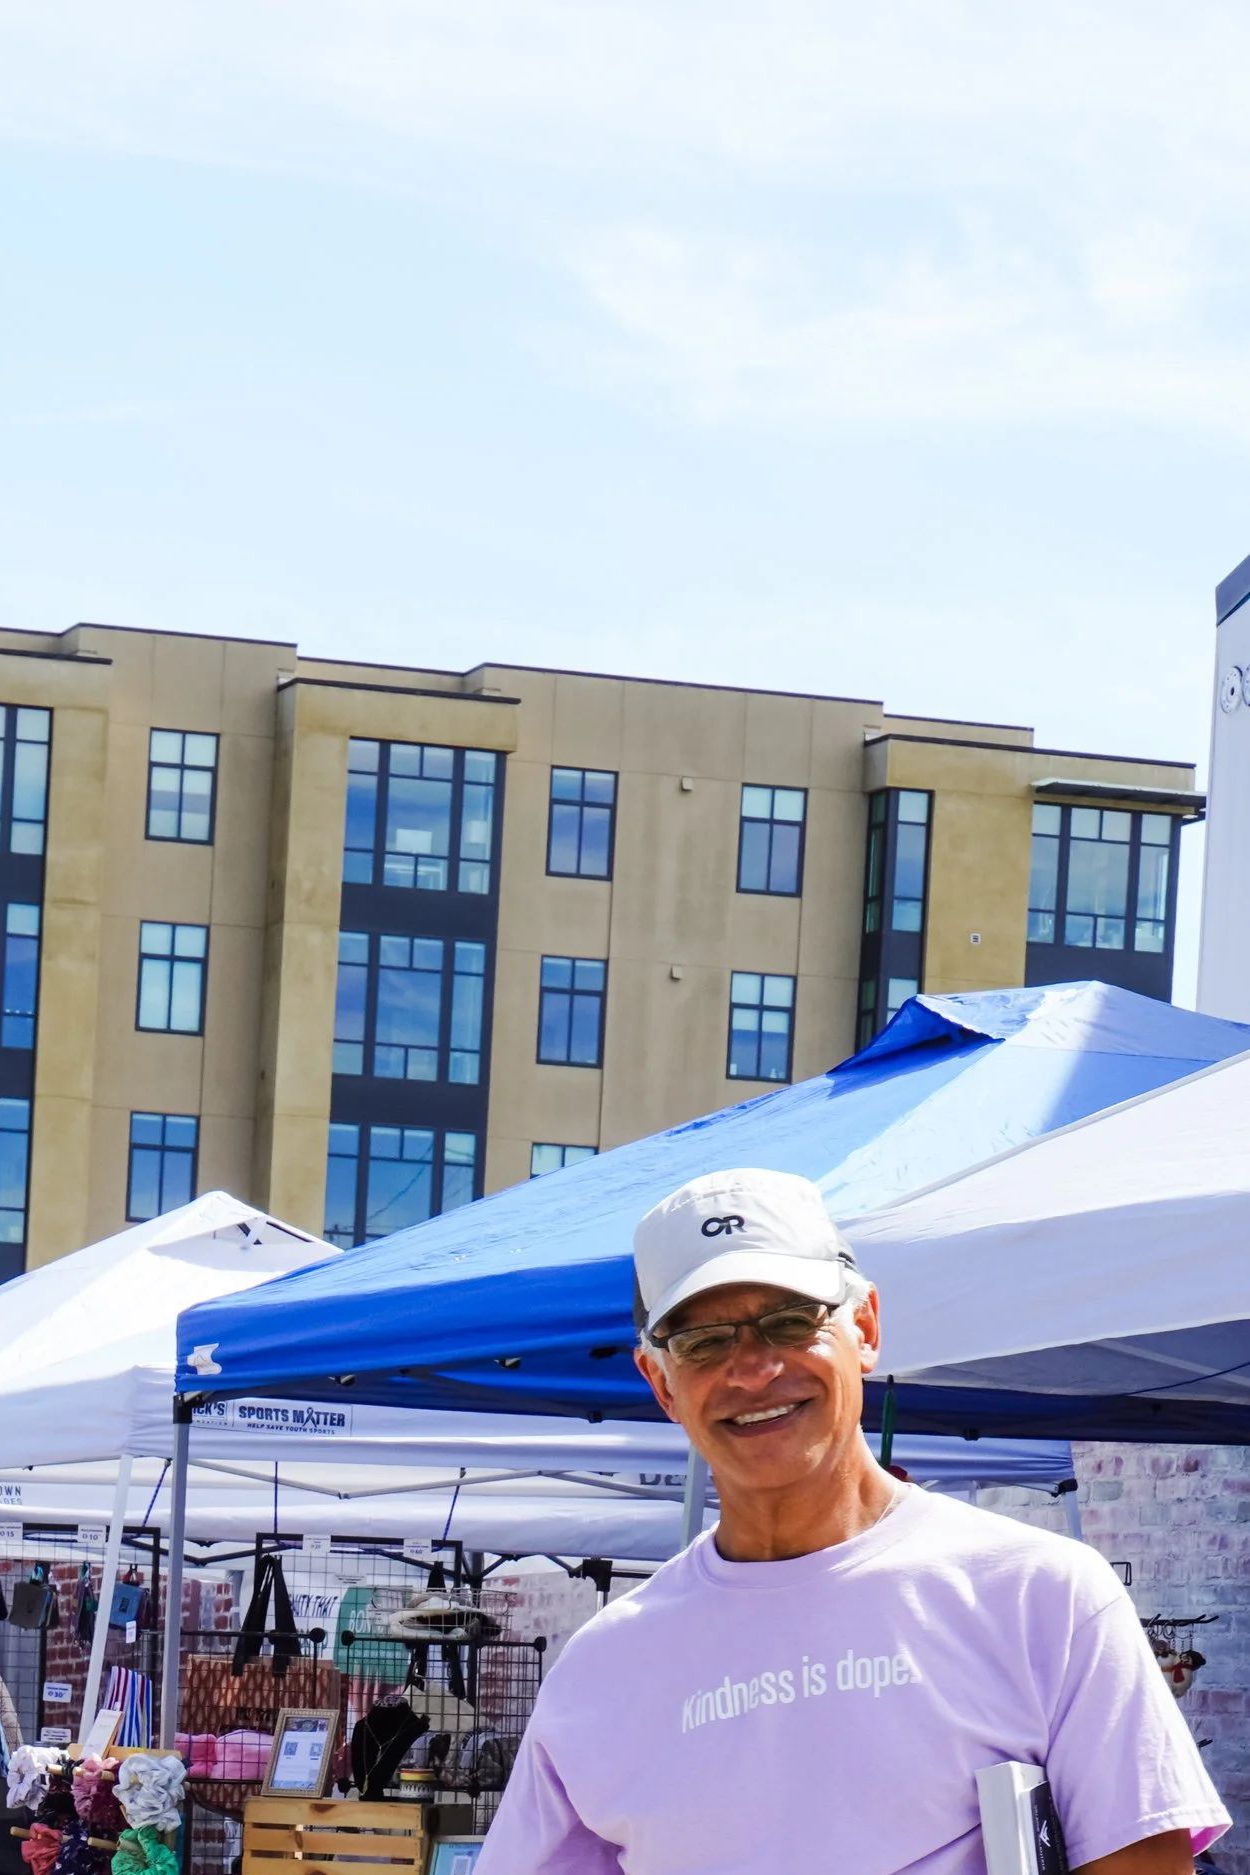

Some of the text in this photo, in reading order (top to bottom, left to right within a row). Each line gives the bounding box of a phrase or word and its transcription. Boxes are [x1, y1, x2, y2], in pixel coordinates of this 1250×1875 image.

[701, 1214, 748, 1238] OR
[238, 1405, 346, 1428] SPORTS MATTER
[285, 1425, 308, 1433] YOUTH
[309, 1427, 335, 1435] SPORTS
[802, 1655, 828, 1698] is
